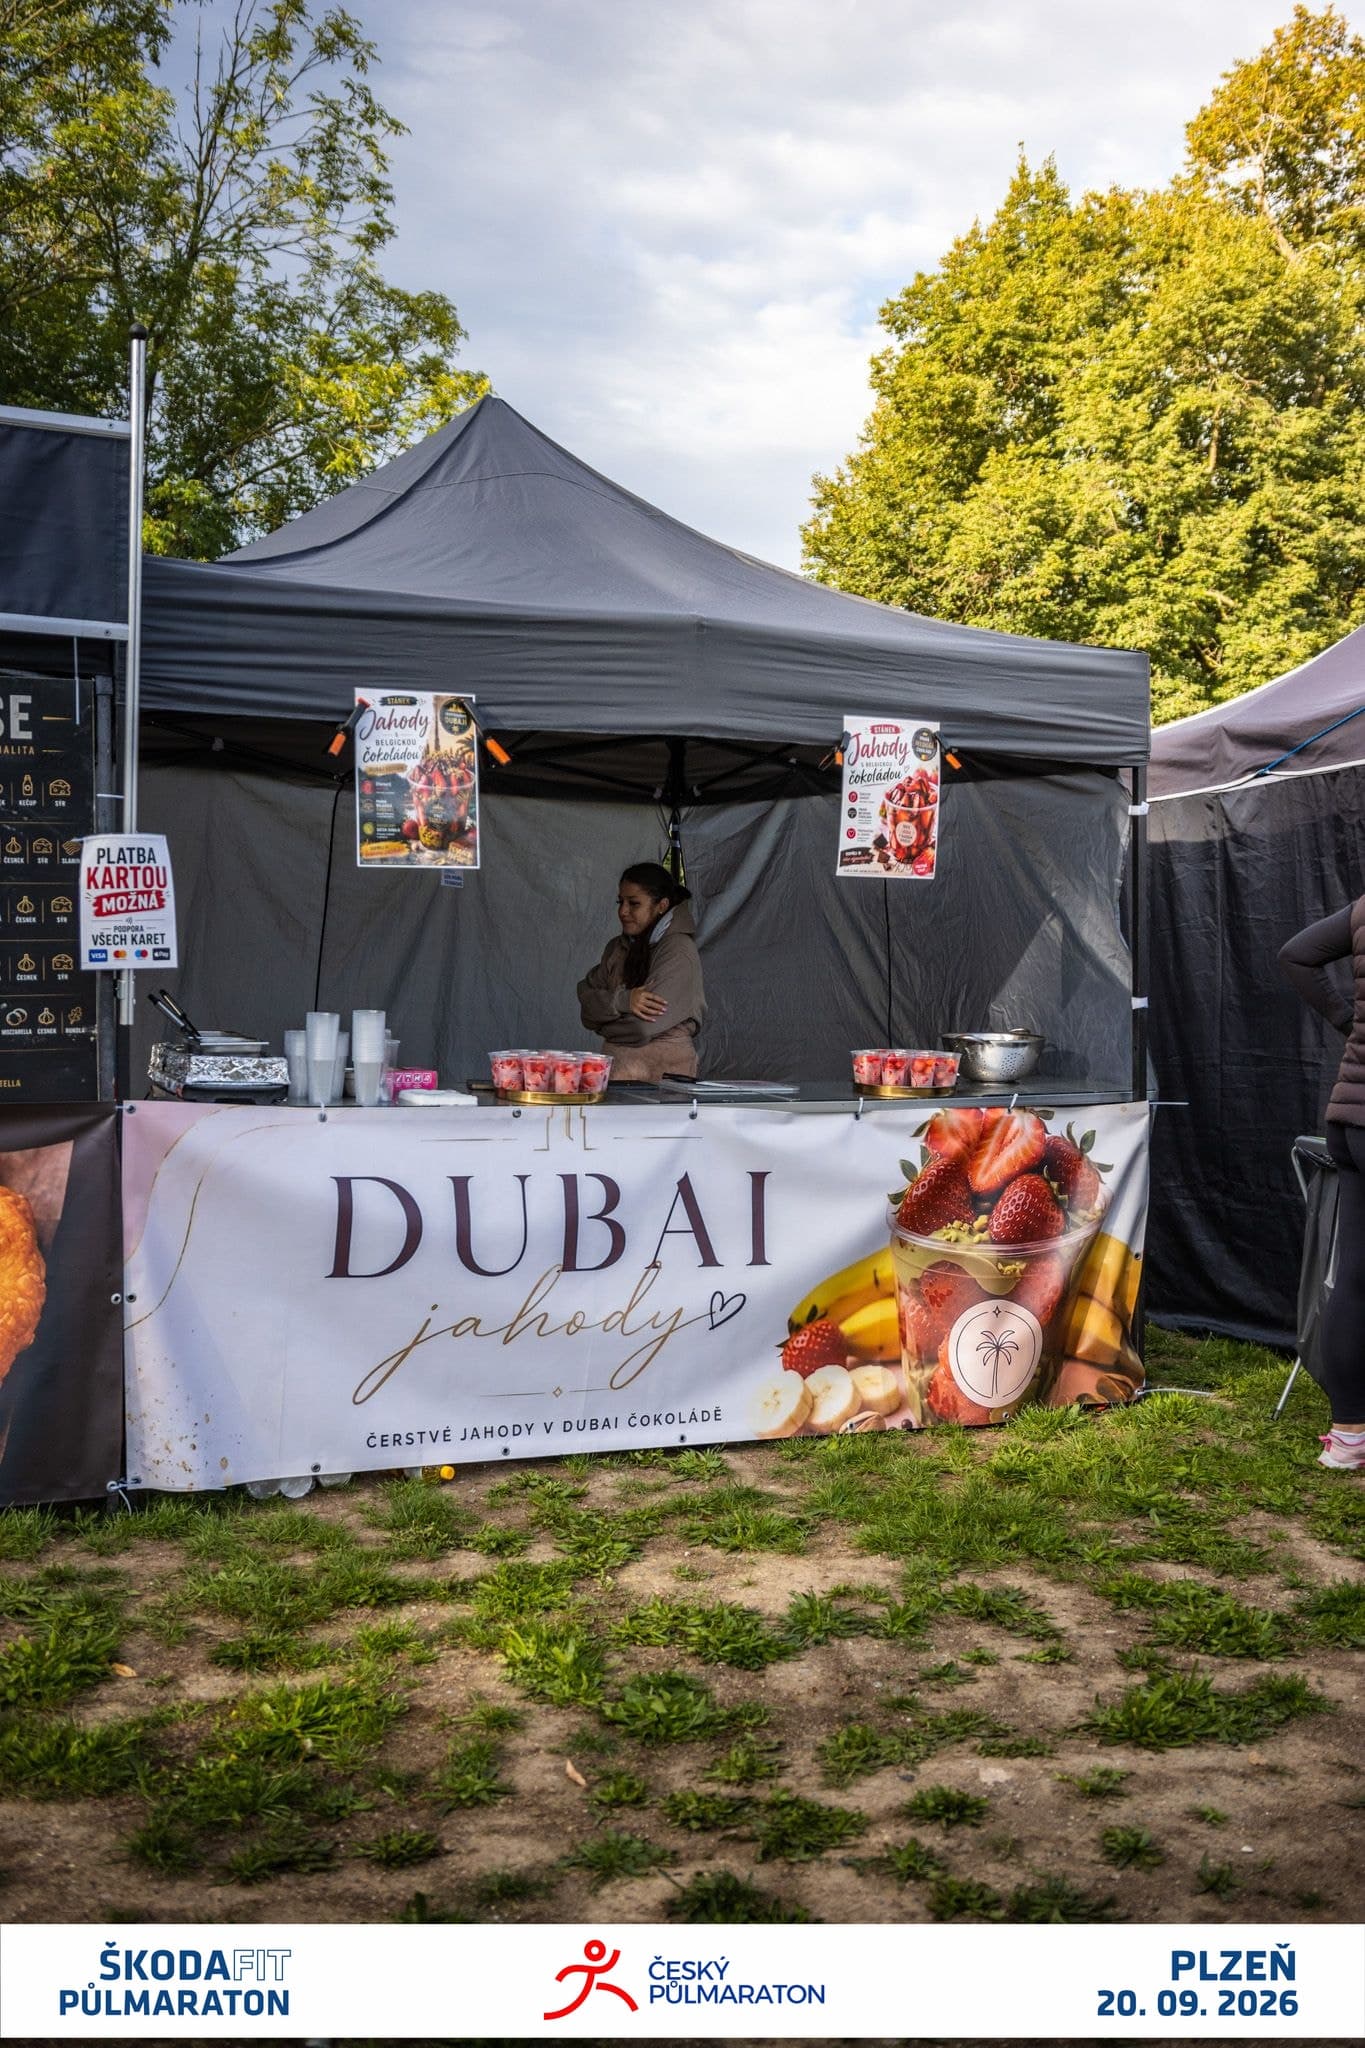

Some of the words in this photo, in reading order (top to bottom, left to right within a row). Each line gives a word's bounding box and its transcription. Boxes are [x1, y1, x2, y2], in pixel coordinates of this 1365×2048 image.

[0, 694, 32, 739] E
[360, 708, 428, 740] Jahody
[848, 733, 909, 766] Jahody
[97, 847, 157, 864] PLATBA
[87, 866, 168, 889] KARTOU
[102, 890, 159, 913] MOŽNÁ
[92, 932, 127, 946] VŠECH
[131, 933, 166, 945] KARET
[113, 925, 144, 933] PODPORA
[324, 1171, 773, 1279] DUBAI
[352, 1261, 716, 1405] jahody
[366, 1426, 452, 1449] ČERSTVÉ
[460, 1421, 535, 1441] JAHODY
[544, 1421, 554, 1434] V
[563, 1415, 618, 1433] DUBAI
[628, 1406, 723, 1429] ČOKOLÁDĚ
